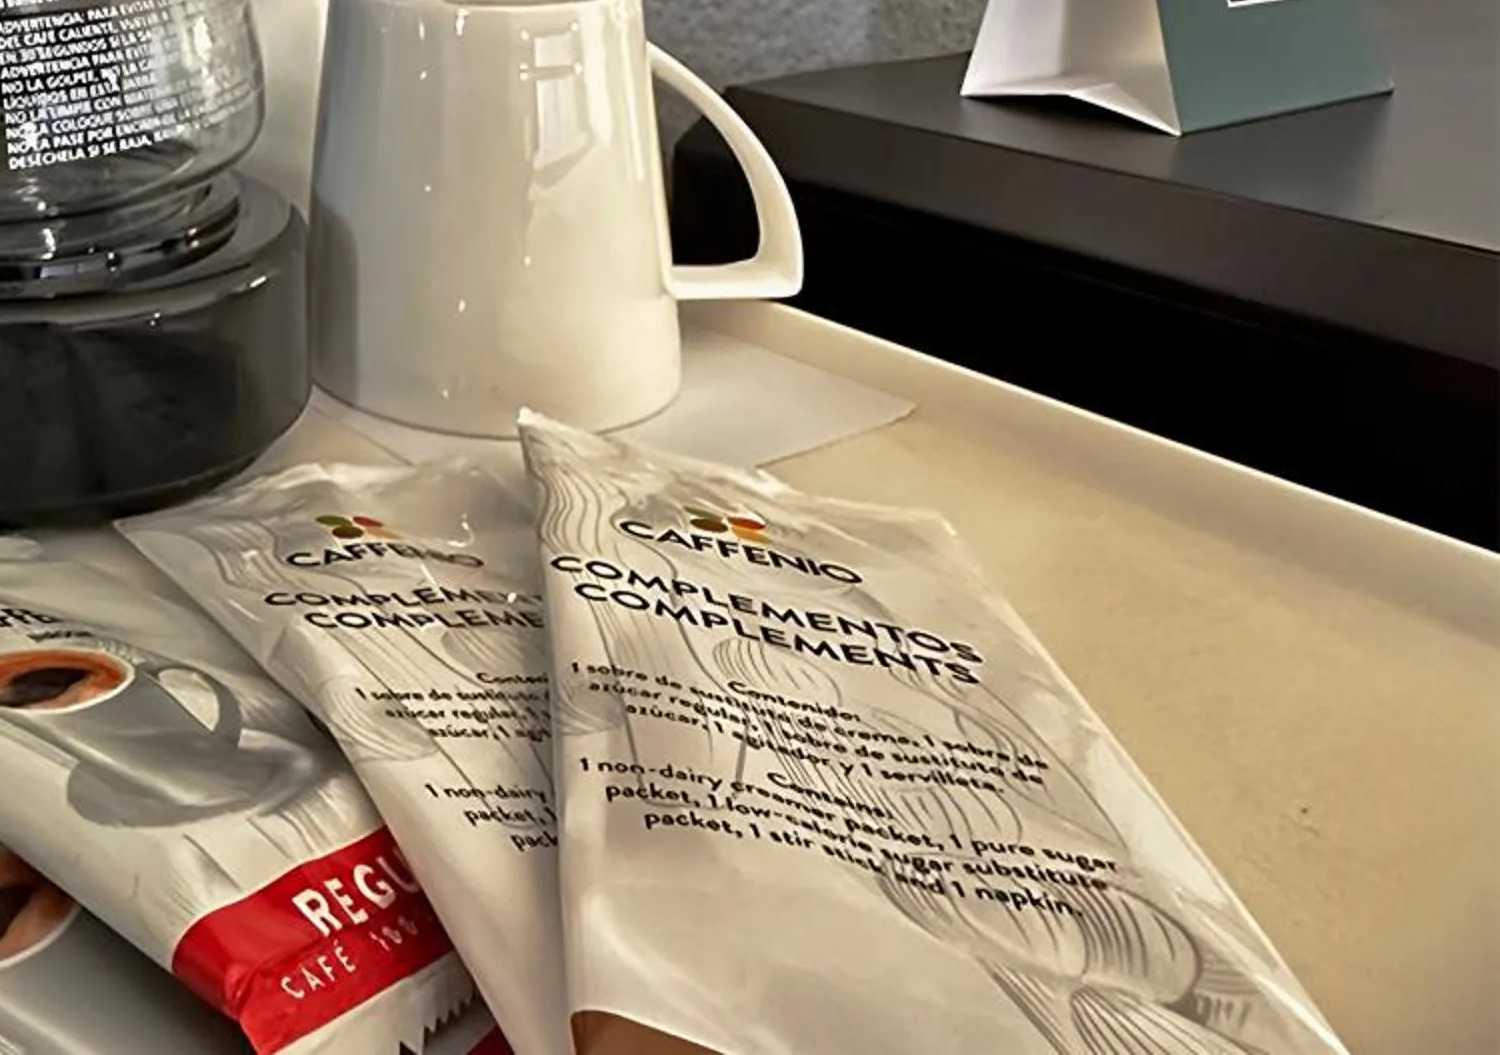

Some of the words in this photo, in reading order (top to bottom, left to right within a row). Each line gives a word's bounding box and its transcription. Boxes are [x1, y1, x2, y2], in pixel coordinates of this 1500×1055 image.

[619, 520, 864, 585] CAFFENIO
[304, 608, 545, 630] COMPLEME
[550, 554, 984, 665] COMPLEMENTOS
[574, 582, 981, 686] COMPLEMENTS
[571, 662, 580, 674] 1
[586, 663, 648, 682] sobre
[654, 669, 682, 690] de
[797, 715, 828, 732] de
[922, 733, 935, 748] 1
[941, 740, 1011, 762] sobre
[1017, 753, 1049, 770] de
[588, 680, 662, 701] azúcar
[854, 744, 885, 761] de
[891, 751, 1005, 779] sustituto
[1011, 768, 1044, 785] de
[712, 720, 725, 734] 1
[860, 762, 873, 777] 1
[424, 783, 439, 798] 1
[443, 784, 547, 804] non-dairy
[464, 806, 546, 827] packet,
[579, 757, 590, 773] 1
[596, 761, 724, 791] non-dairy
[730, 781, 837, 823] creamer
[843, 817, 945, 852] packet,
[949, 833, 963, 850] 1
[971, 838, 1036, 857] pure
[1041, 847, 1119, 874] sugar
[510, 830, 559, 852] pack
[604, 783, 701, 808] packet,
[707, 794, 719, 810] 1
[880, 846, 954, 876] sugar
[962, 859, 1109, 892] substitute
[643, 810, 744, 839] packet,
[749, 823, 762, 839] 1
[769, 830, 815, 850] stir
[894, 872, 946, 896] and
[950, 880, 966, 898] 1
[974, 886, 1083, 918] napkin.
[292, 854, 421, 938] REGU
[280, 938, 356, 1000] CAFÉ
[369, 915, 419, 952] 100
